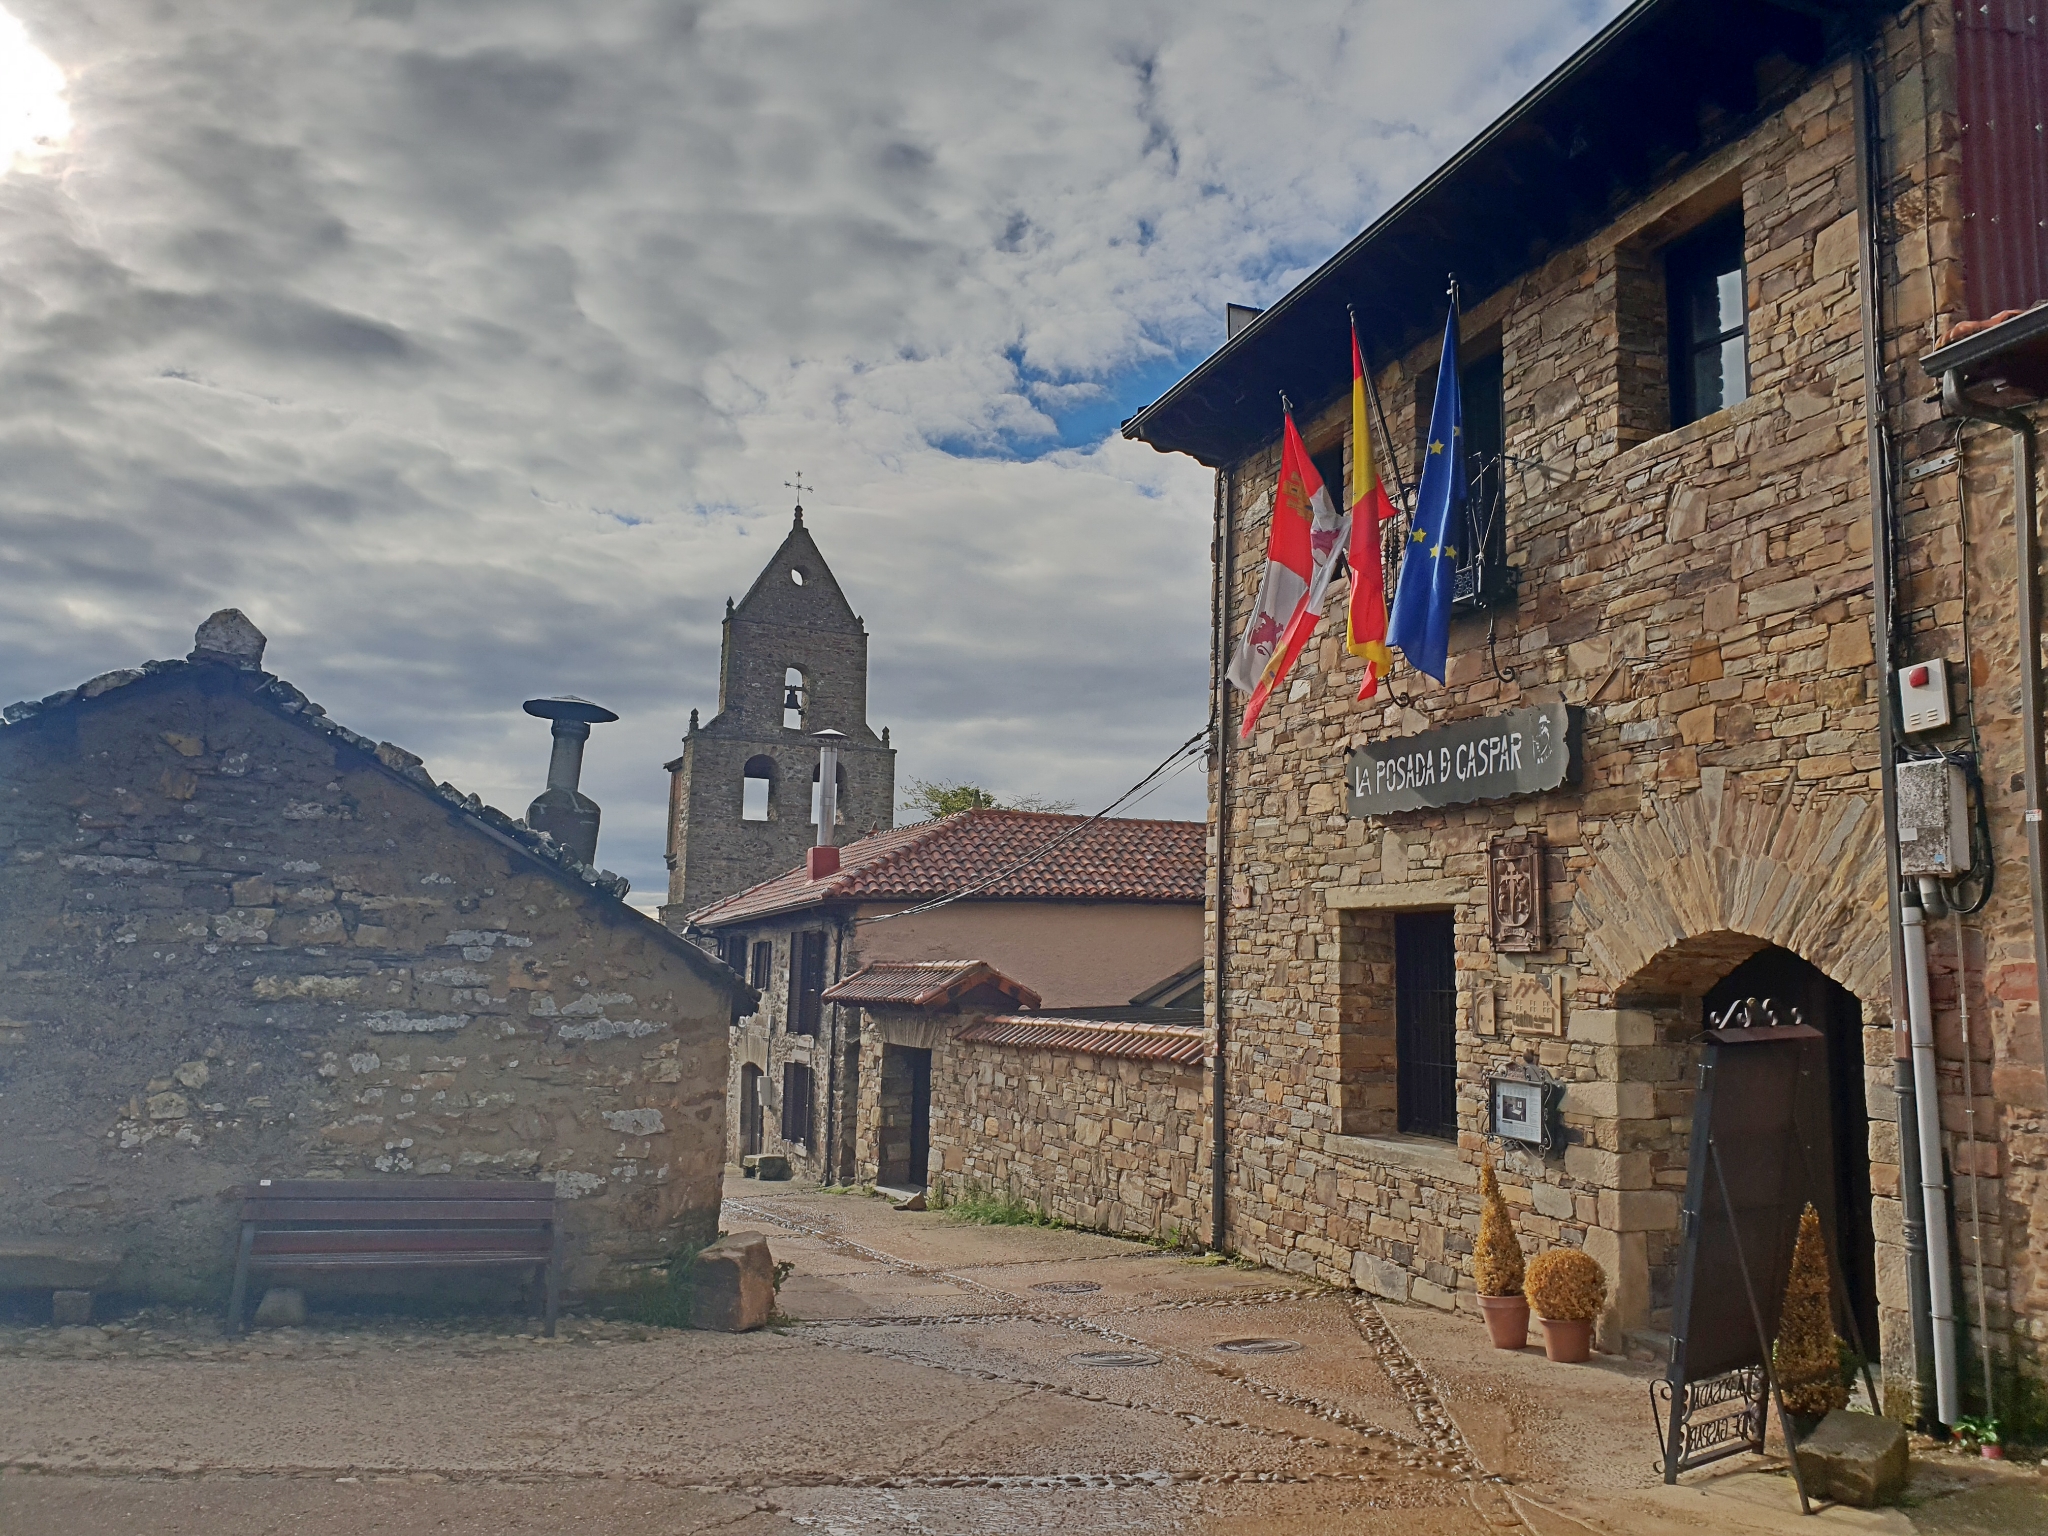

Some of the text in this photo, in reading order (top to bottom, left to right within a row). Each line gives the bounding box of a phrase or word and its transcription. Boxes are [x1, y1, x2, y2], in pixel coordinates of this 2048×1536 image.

[1355, 766, 1372, 798] LA
[1376, 749, 1436, 794] POSADA
[1456, 732, 1522, 782] GASPAR
